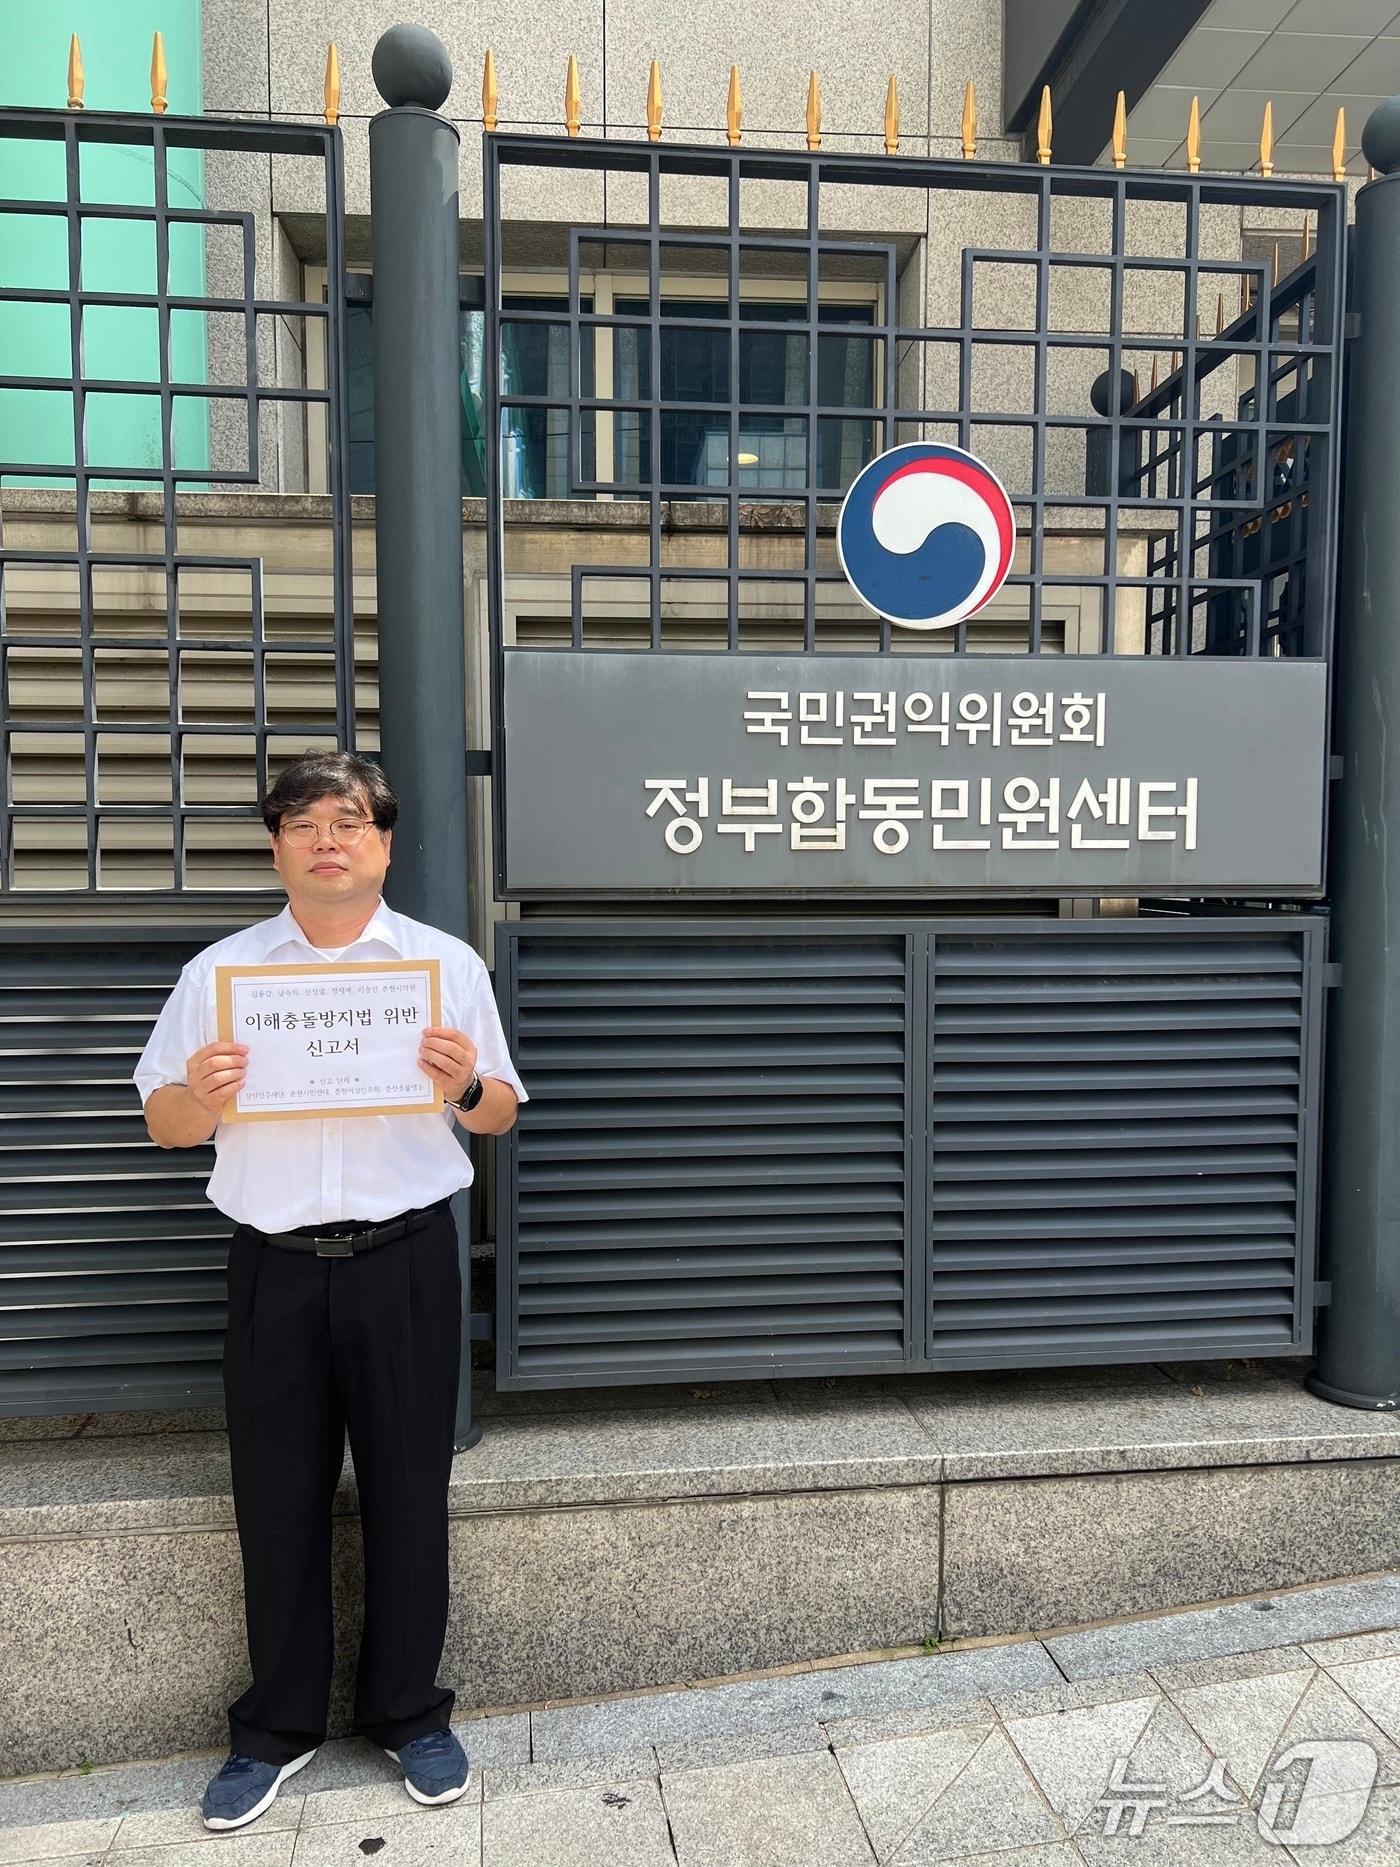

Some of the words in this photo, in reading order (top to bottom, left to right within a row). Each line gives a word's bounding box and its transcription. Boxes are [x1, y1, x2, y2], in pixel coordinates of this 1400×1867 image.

[743, 690, 1107, 748] 국민권익위원회
[642, 775, 1199, 856] 정부합동민원센터
[245, 1007, 372, 1032] 이해충돌방지법
[383, 1006, 419, 1026] 위반
[305, 1037, 360, 1059] 신고서
